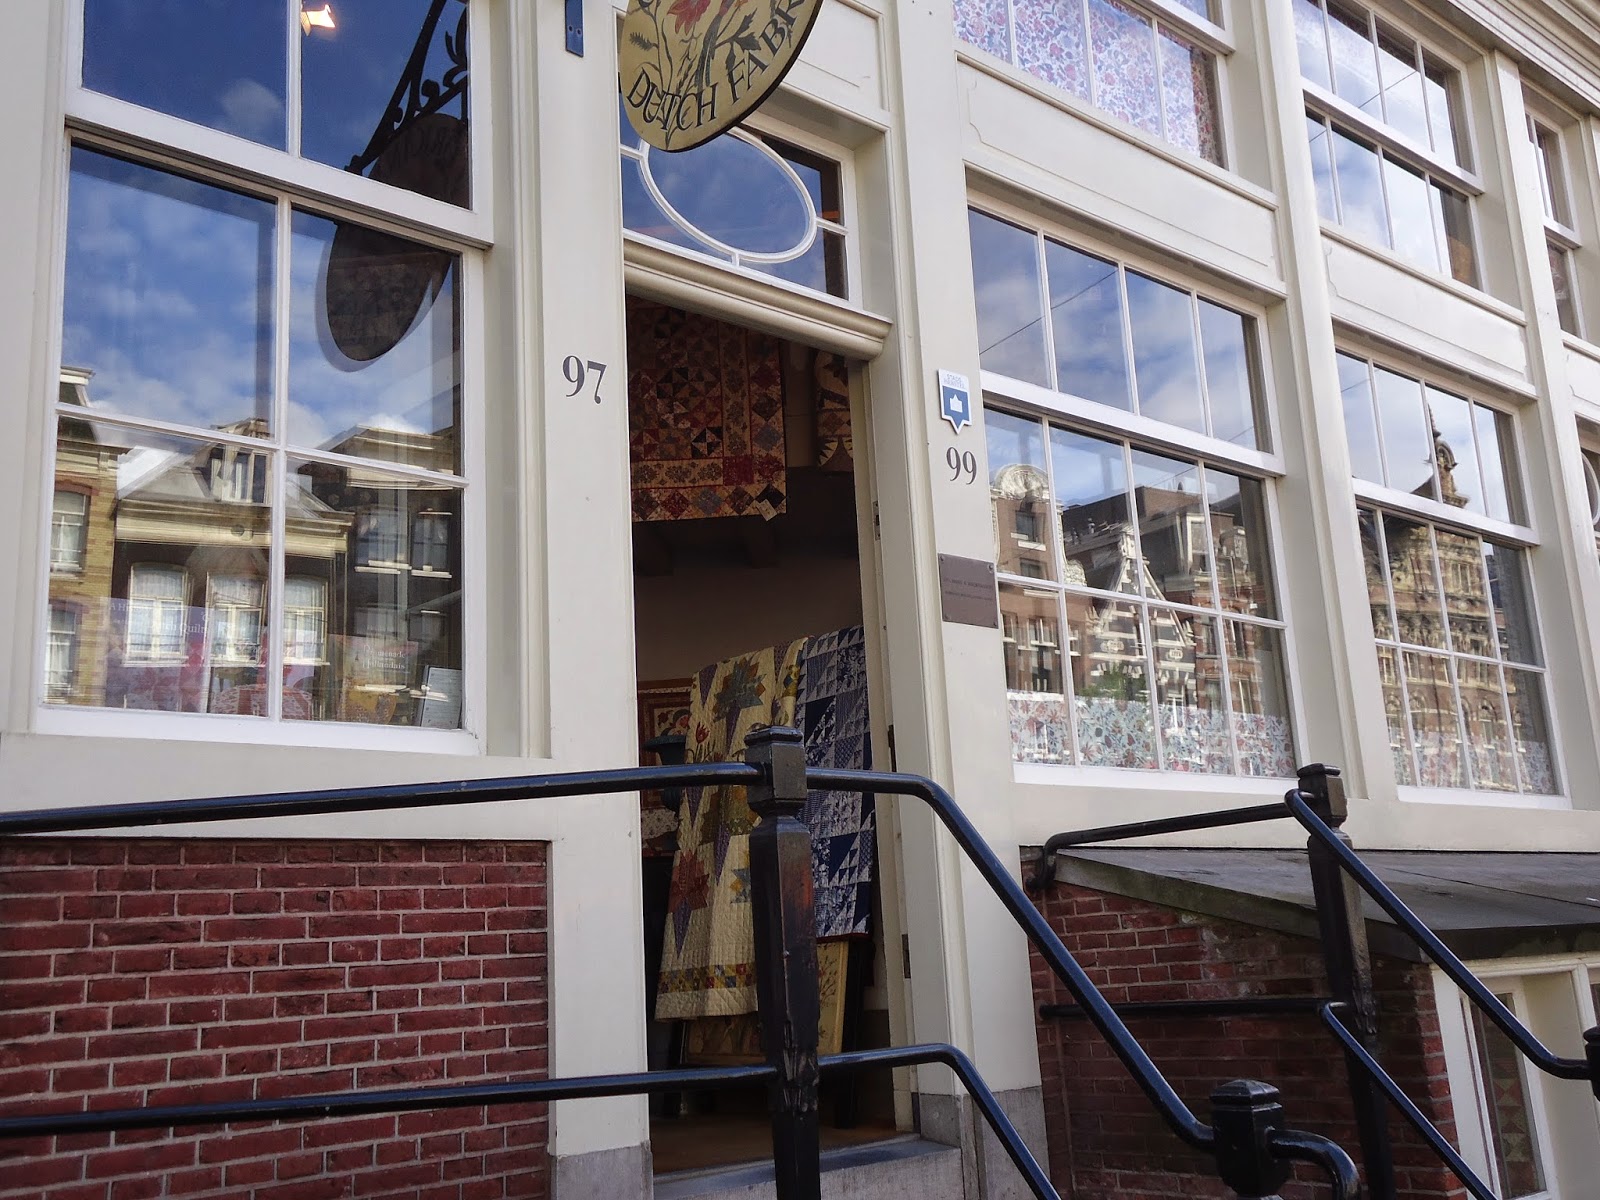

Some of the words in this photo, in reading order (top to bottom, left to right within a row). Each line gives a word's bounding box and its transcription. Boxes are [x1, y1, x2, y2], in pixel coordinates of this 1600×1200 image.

[626, 66, 718, 132] DUTCH
[562, 355, 607, 404] 97
[946, 446, 977, 485] 99
